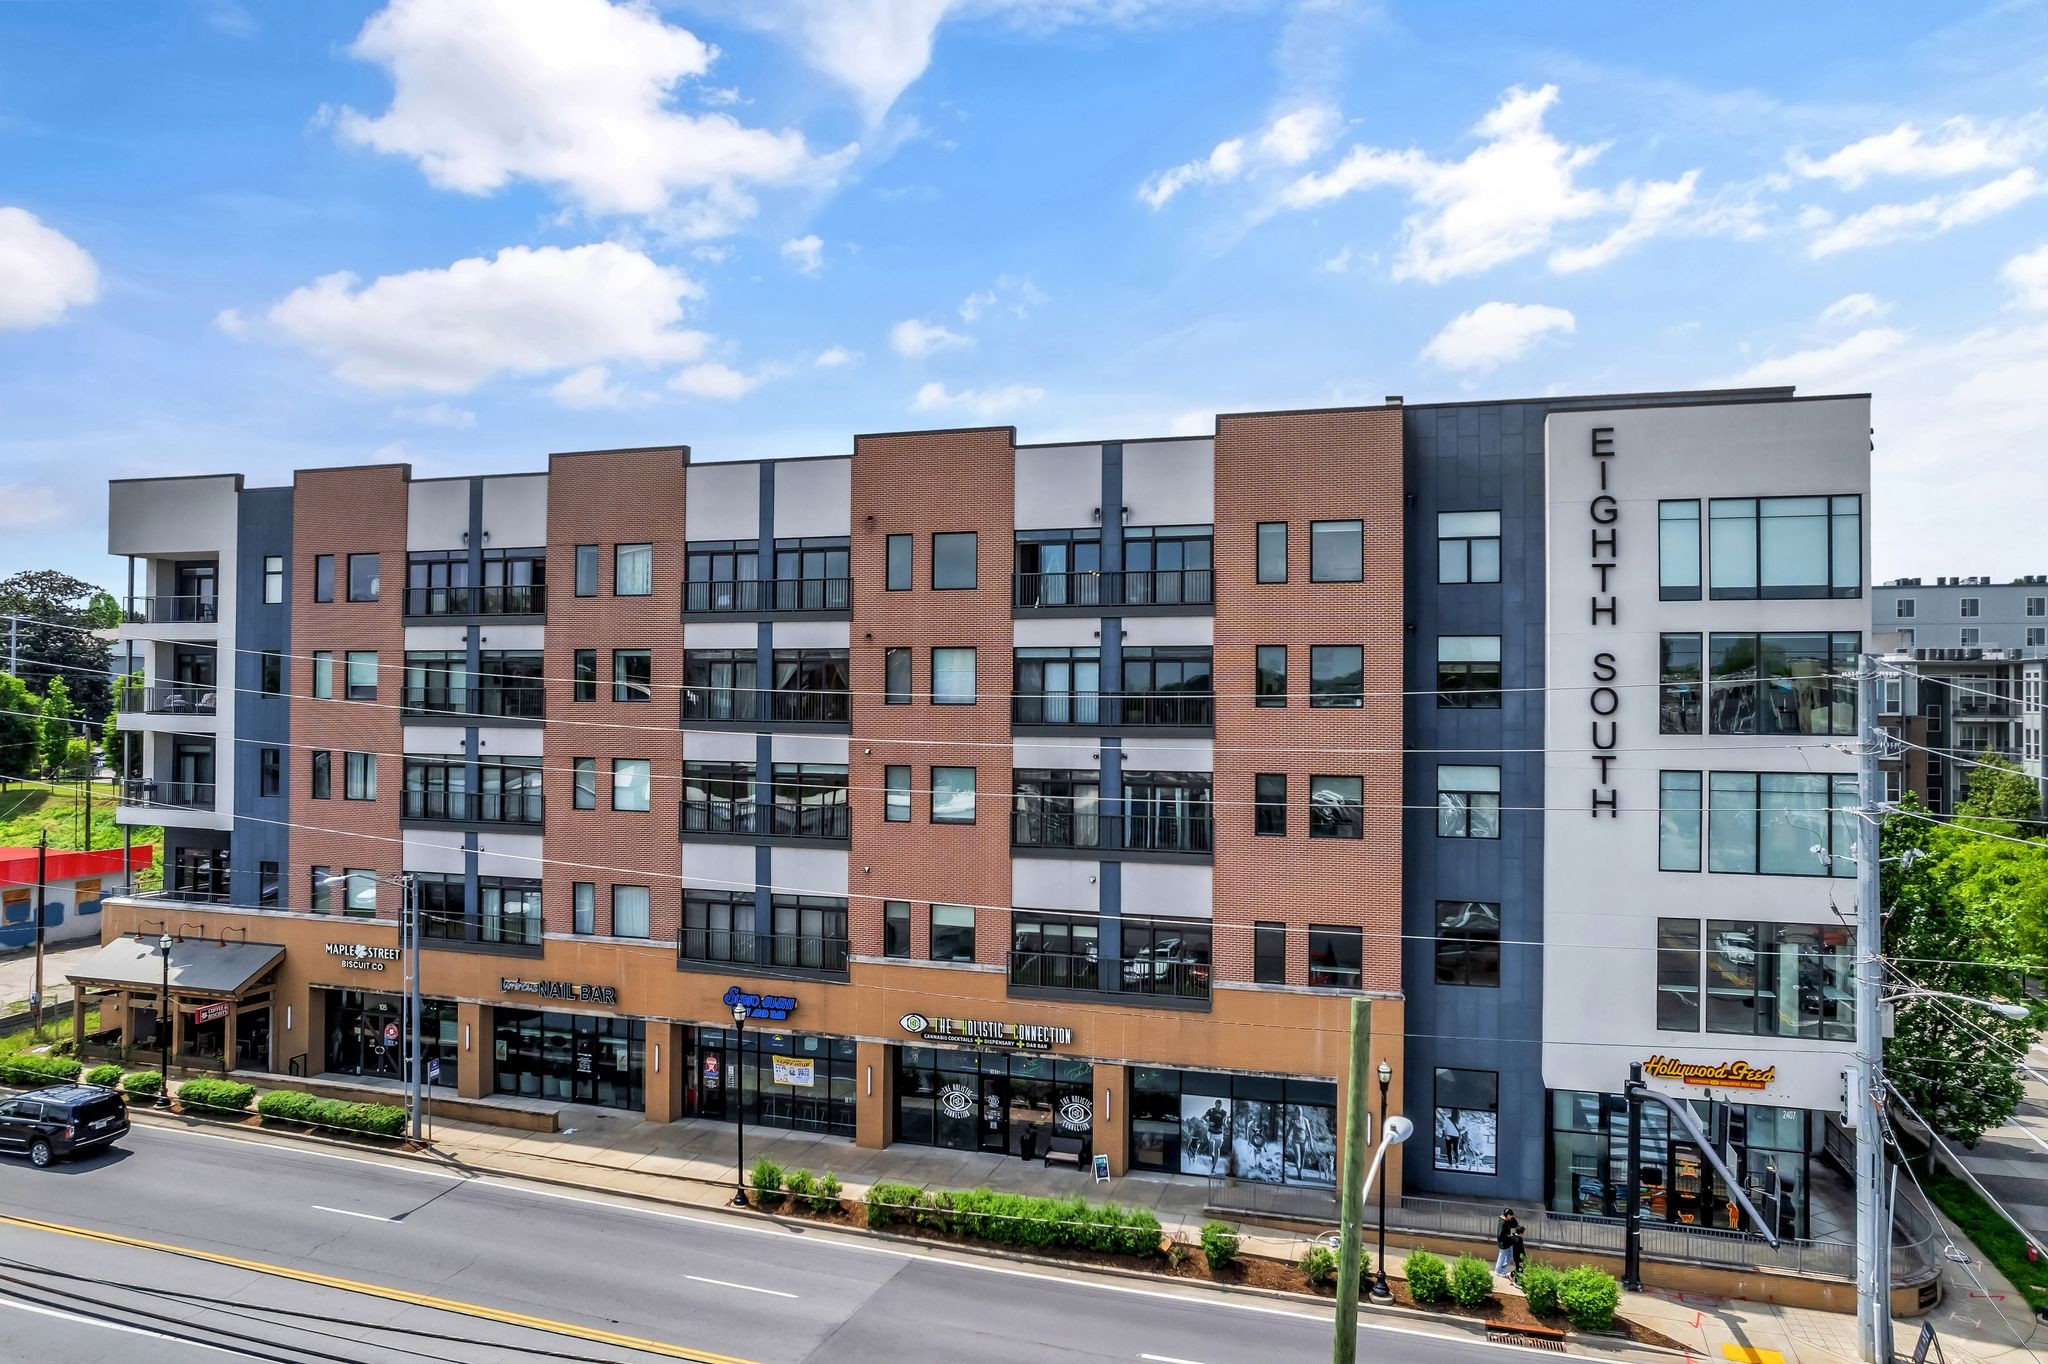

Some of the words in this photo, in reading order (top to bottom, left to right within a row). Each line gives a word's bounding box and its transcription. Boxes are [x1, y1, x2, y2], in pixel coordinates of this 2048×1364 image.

[1590, 427, 1618, 625] EIGHTH
[1590, 652, 1619, 818] SOUTH
[325, 943, 355, 957] MAPLE
[367, 946, 401, 960] STREET
[341, 960, 370, 970] BISCUIT
[371, 963, 385, 972] CO
[539, 981, 577, 1001] NAIL
[580, 984, 616, 1005] BAR
[379, 1003, 388, 1011] 105
[923, 1033, 948, 1041] CANNABIS
[933, 1017, 952, 1034] THE
[962, 1019, 1003, 1038] HOLISTIC
[1012, 1023, 1072, 1045] CONNECTION
[984, 1039, 1015, 1047] DISPENSARY
[1643, 1055, 1729, 1079] Hollywood
[1729, 1061, 1776, 1082] Feed
[941, 1084, 951, 1094] THE
[952, 1083, 973, 1097] HOLISTIC
[1060, 1096, 1071, 1106] THE
[1071, 1095, 1093, 1109] HOLISTIC
[943, 1107, 971, 1119] CONNECTION
[1782, 1110, 1797, 1120] 2407
[1062, 1120, 1090, 1132] CONNECTION
